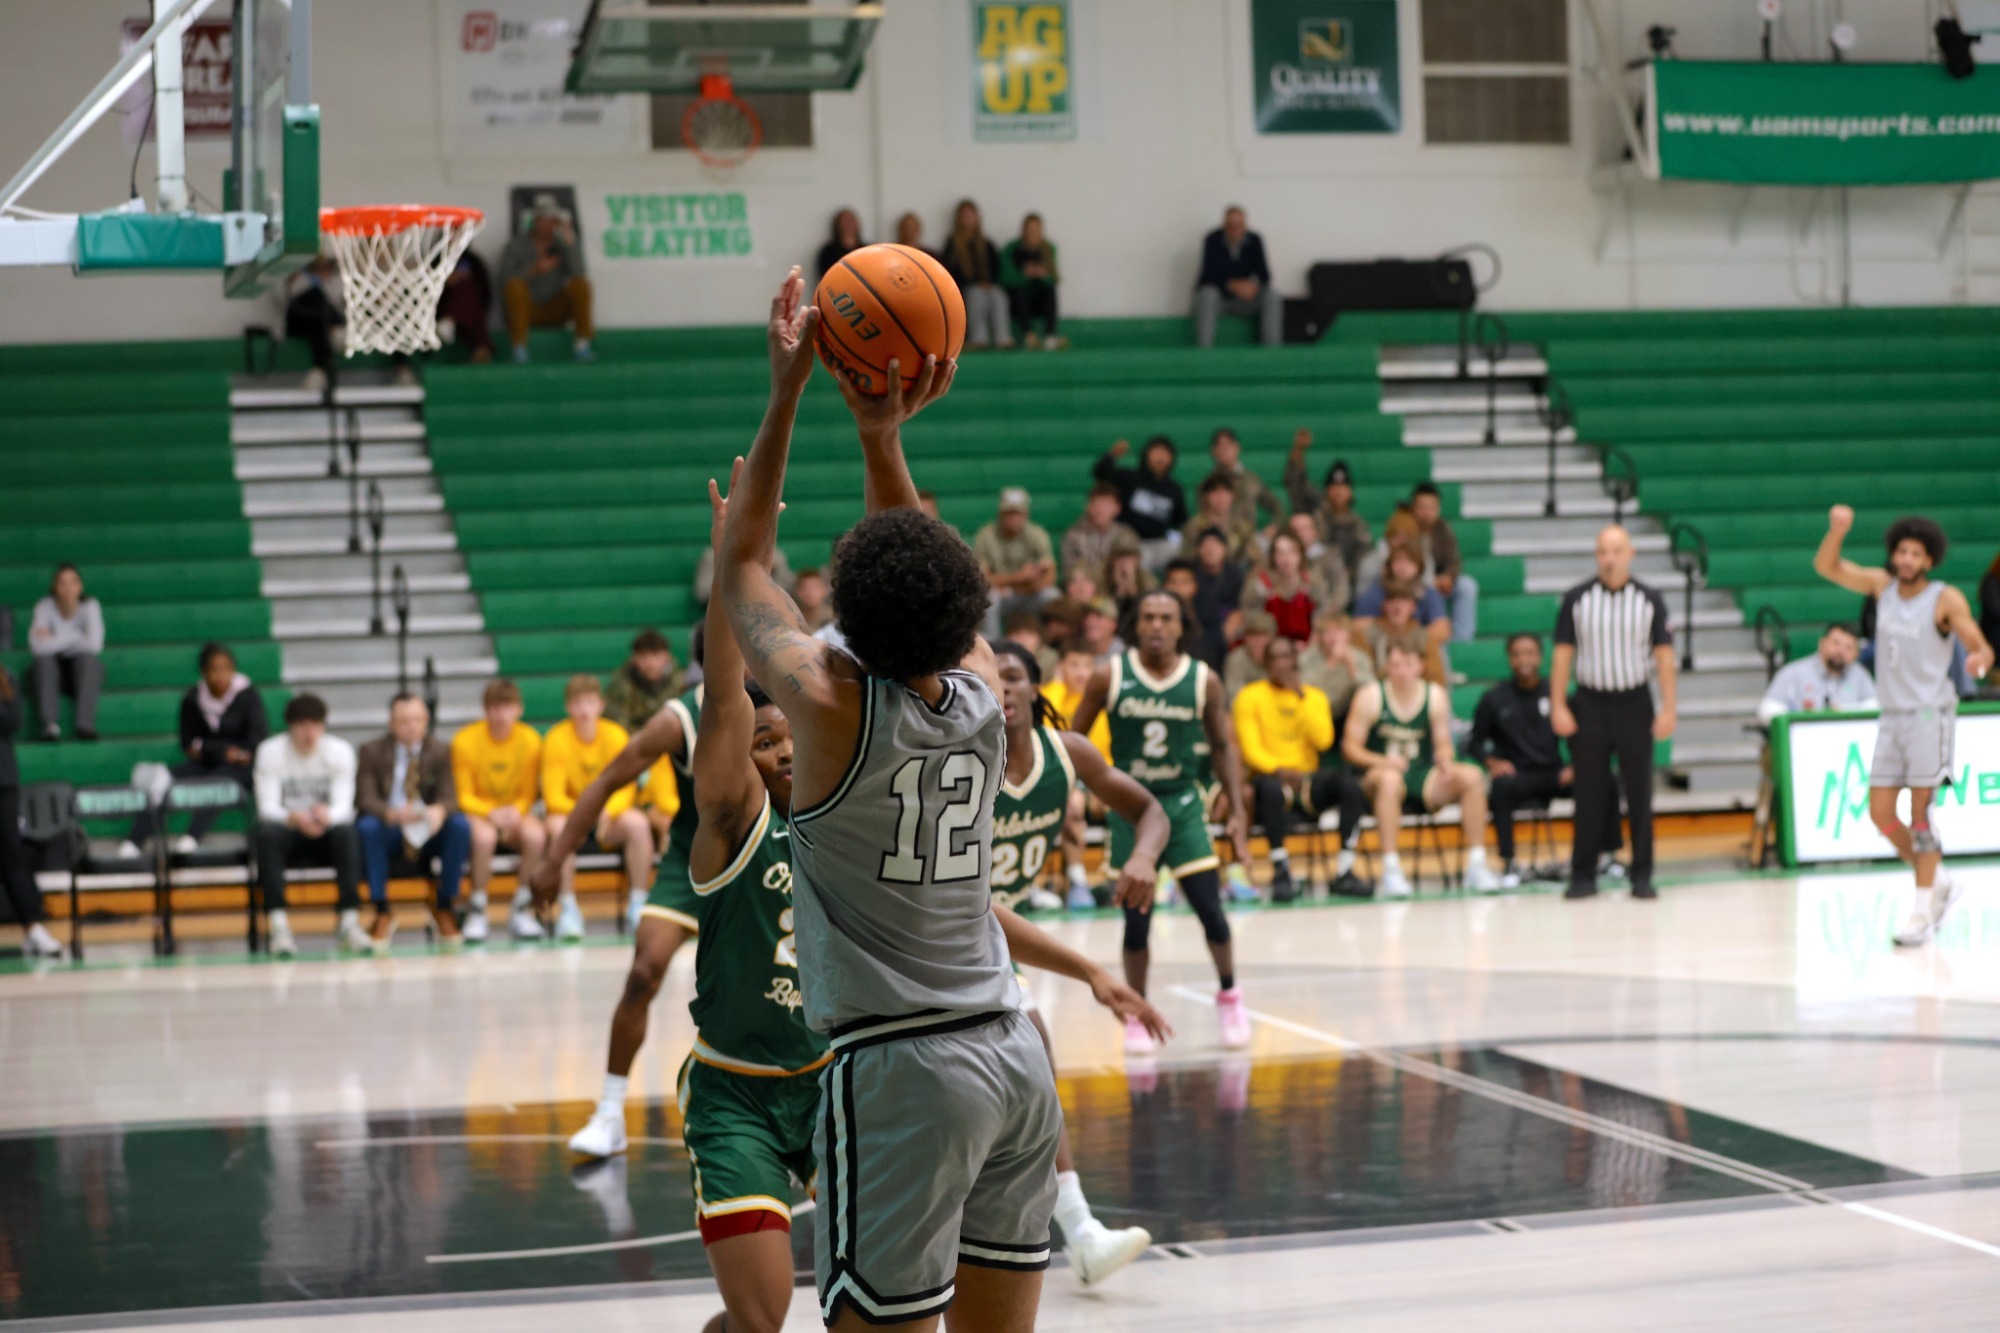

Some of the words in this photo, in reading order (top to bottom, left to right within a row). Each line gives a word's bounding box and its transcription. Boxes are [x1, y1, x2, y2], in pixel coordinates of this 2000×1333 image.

[978, 6, 1063, 60] AG
[983, 61, 1069, 114] UP
[1662, 112, 2000, 142] www.uamsports.com
[604, 192, 747, 224] VISITOR
[602, 227, 753, 259] SEATING
[832, 292, 882, 342] EVO
[1142, 720, 1169, 759] 2
[877, 750, 987, 886] 12
[990, 834, 1047, 886] 20
